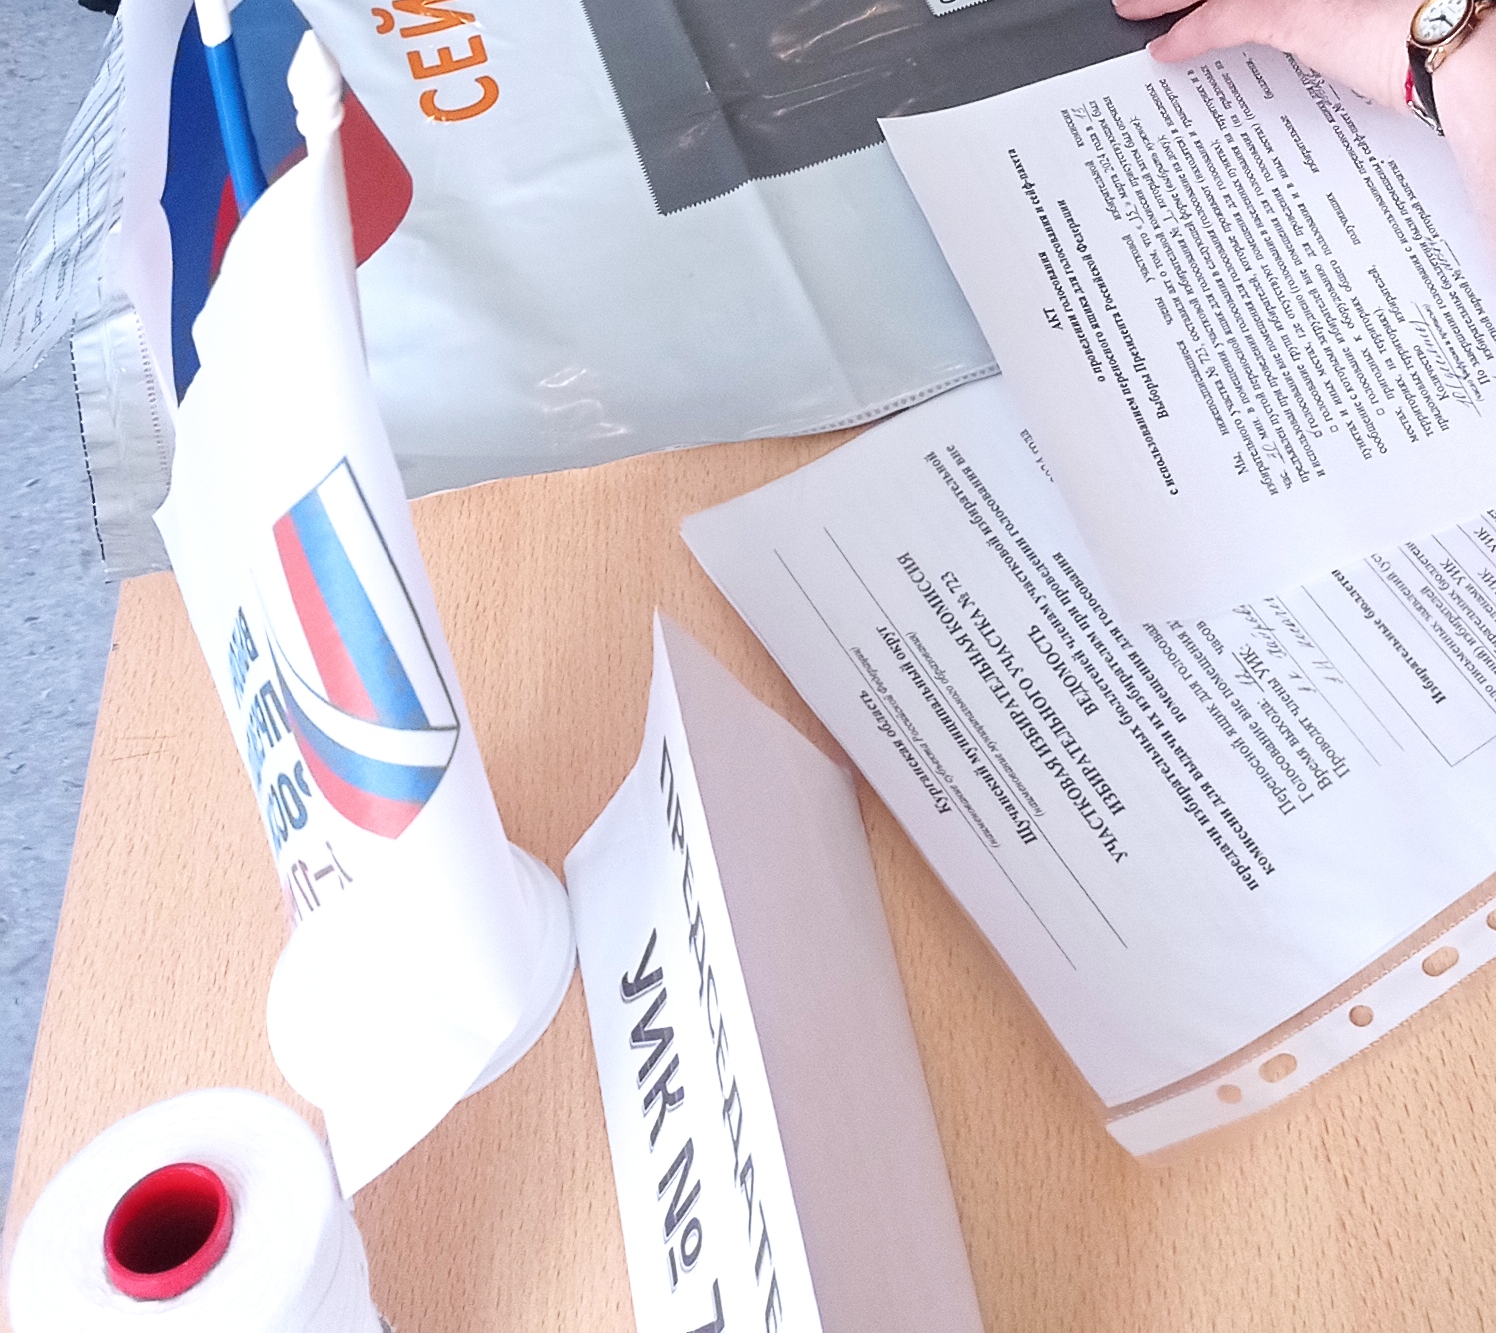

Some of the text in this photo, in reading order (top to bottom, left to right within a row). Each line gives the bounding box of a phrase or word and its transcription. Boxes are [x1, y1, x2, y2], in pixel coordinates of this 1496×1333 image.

[1007, 148, 1179, 496] с использованием переносного ящика для голосования и сейф-пакета
[1037, 251, 1106, 383] о проведении голосования
[1042, 307, 1064, 331] АКТ
[1056, 199, 1170, 420] Выборы Президента Российской Федерации
[1386, 571, 1432, 622] заявлений
[1404, 541, 1451, 591] бюллетен
[1419, 585, 1477, 647] избирателей
[1439, 557, 1467, 587] УИК
[923, 451, 1260, 892] передачи избирательных бюллетеней членам участковой избирательной
[940, 571, 1126, 817] ИЗБИРАТЕЛЬНОГО УЧАСТКА № 723
[946, 445, 1276, 876] комиссии для выдачи их избирателям при проведении голосования вне
[1027, 624, 1100, 717] ВЕДОМОСТЬ
[1051, 551, 1188, 724] помещения для голосования
[1196, 620, 1225, 656] часов
[1330, 569, 1447, 705] Избирательные бюллетен
[1430, 620, 1488, 685] письменных
[848, 646, 1001, 849] (наименование субъекта Российской Федерации)
[859, 689, 953, 815] Курганская область
[875, 626, 1038, 846] Щучанский муниципальный округ
[896, 551, 1129, 864] УЧАСТКОВАЯ ИЗБИРАТЕЛЬНАЯ КОМИССИЯ
[1142, 622, 1297, 816] Переносной ящик для голосован
[1176, 630, 1315, 804] Голосование вне помещения
[1239, 643, 1351, 779] Проводят члены УИК:
[1256, 697, 1301, 748] выхода:
[1295, 746, 1334, 792] Время
[659, 734, 785, 1333] ПРЕДСЕДАТЕ
[620, 927, 703, 1293] УИК №
